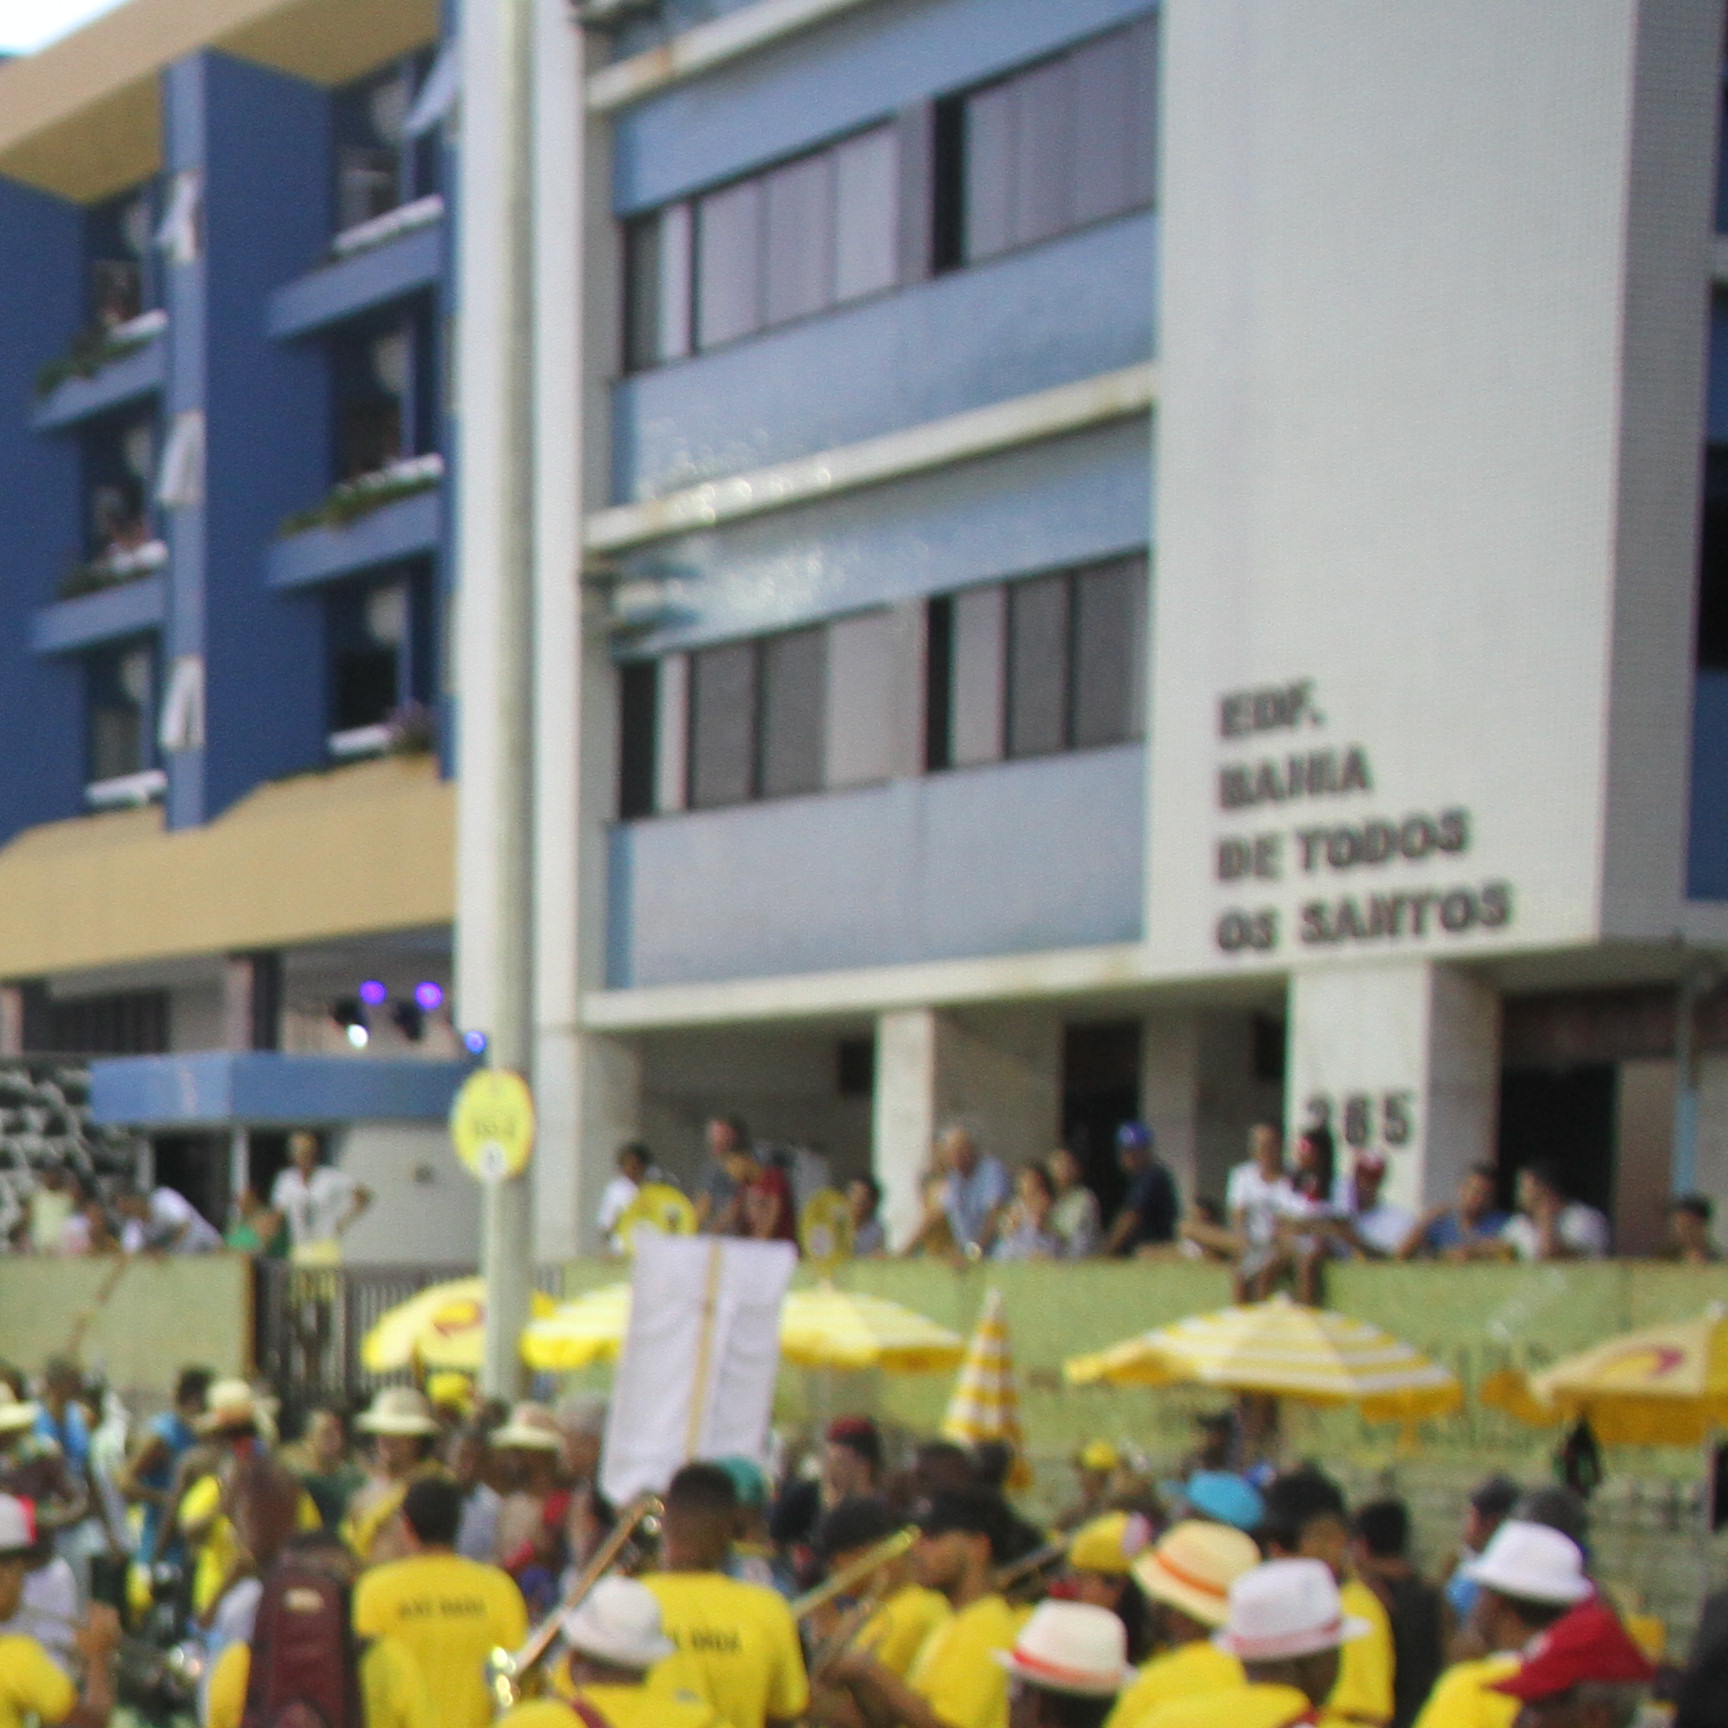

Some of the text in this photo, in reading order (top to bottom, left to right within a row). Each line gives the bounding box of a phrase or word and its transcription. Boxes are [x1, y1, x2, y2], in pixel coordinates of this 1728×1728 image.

[1218, 676, 1327, 739] EDF.
[1218, 746, 1372, 812] BAHIA
[1217, 806, 1468, 882] DE TODOS
[1217, 880, 1512, 952] OS SANTOS
